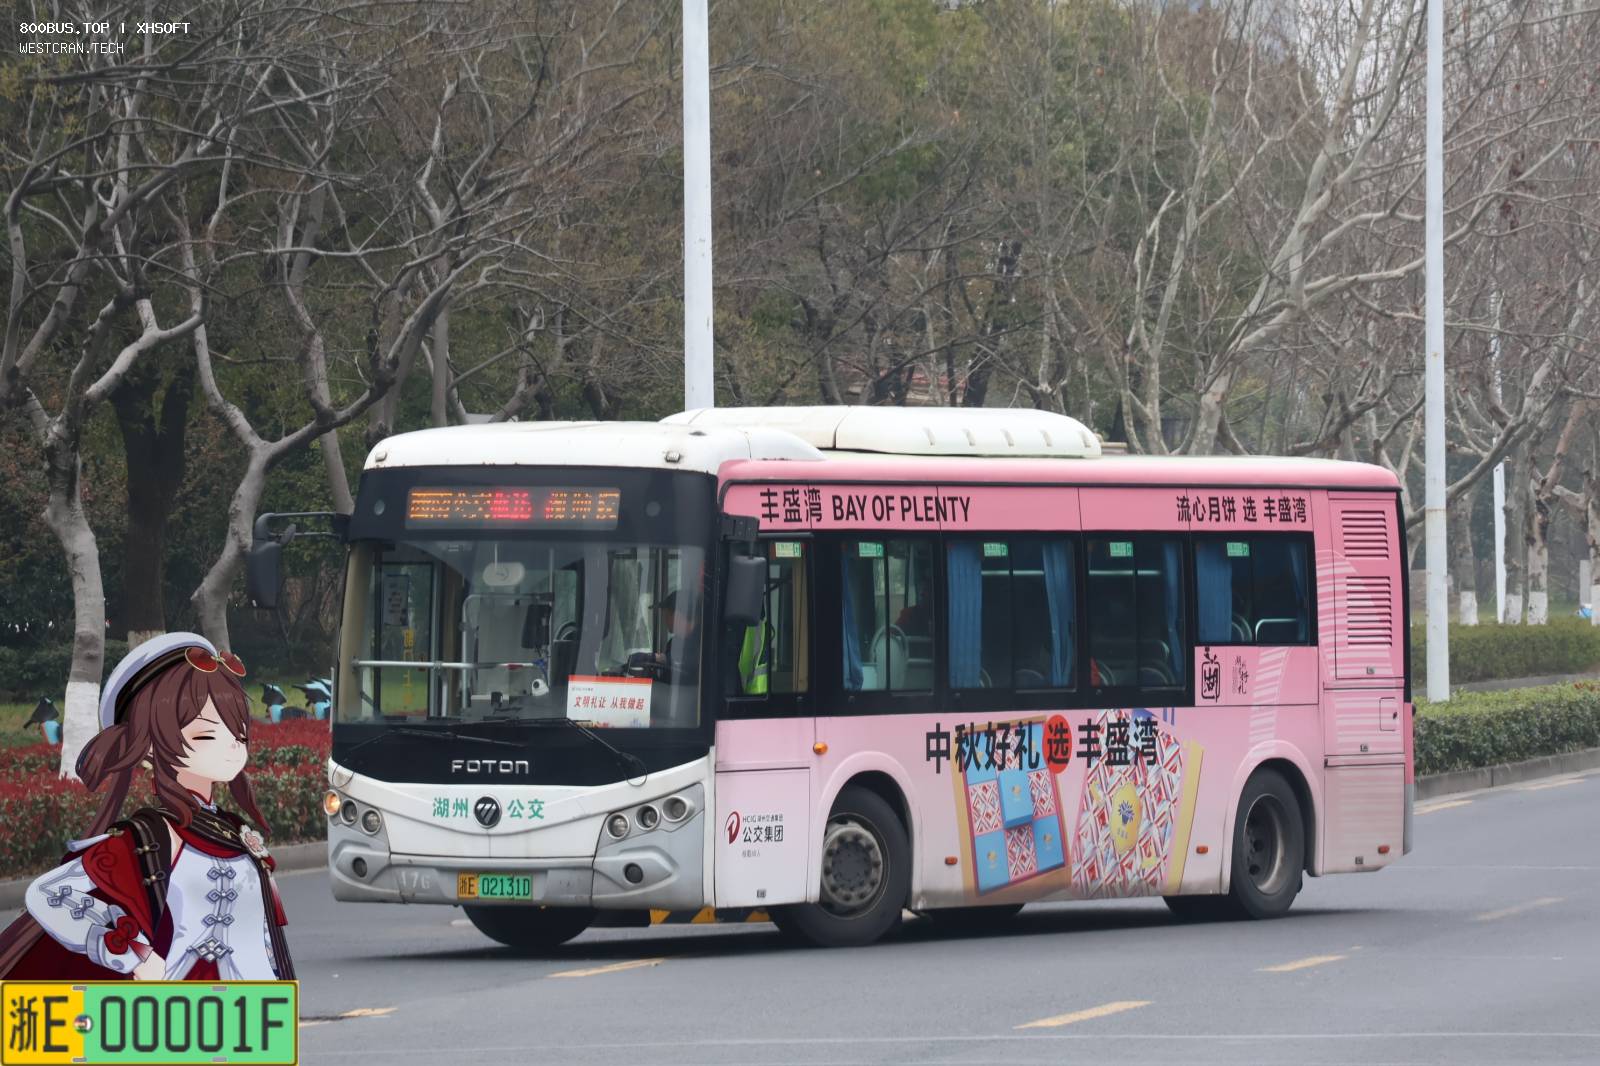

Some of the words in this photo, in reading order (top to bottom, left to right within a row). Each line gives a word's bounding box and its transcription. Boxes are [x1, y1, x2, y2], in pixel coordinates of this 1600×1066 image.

[760, 488, 822, 522] 丰盛湾
[831, 494, 867, 521] BAY
[871, 495, 895, 521] OF
[900, 496, 970, 522] PLENTY
[1176, 496, 1237, 523] 流心月饼
[1242, 496, 1257, 522] 选
[1263, 496, 1307, 523] 丰盛湾
[574, 695, 606, 709] 文明礼让
[610, 696, 644, 711] 从我做起
[926, 721, 1039, 774] 中秋好礼
[1047, 724, 1070, 764] 选
[1076, 717, 1159, 769] 丰盛湾
[451, 760, 529, 775] FOTON
[432, 797, 469, 819] 湖州
[507, 798, 545, 820] 公交
[743, 825, 784, 843] 公交集团
[481, 877, 530, 897] 02131D
